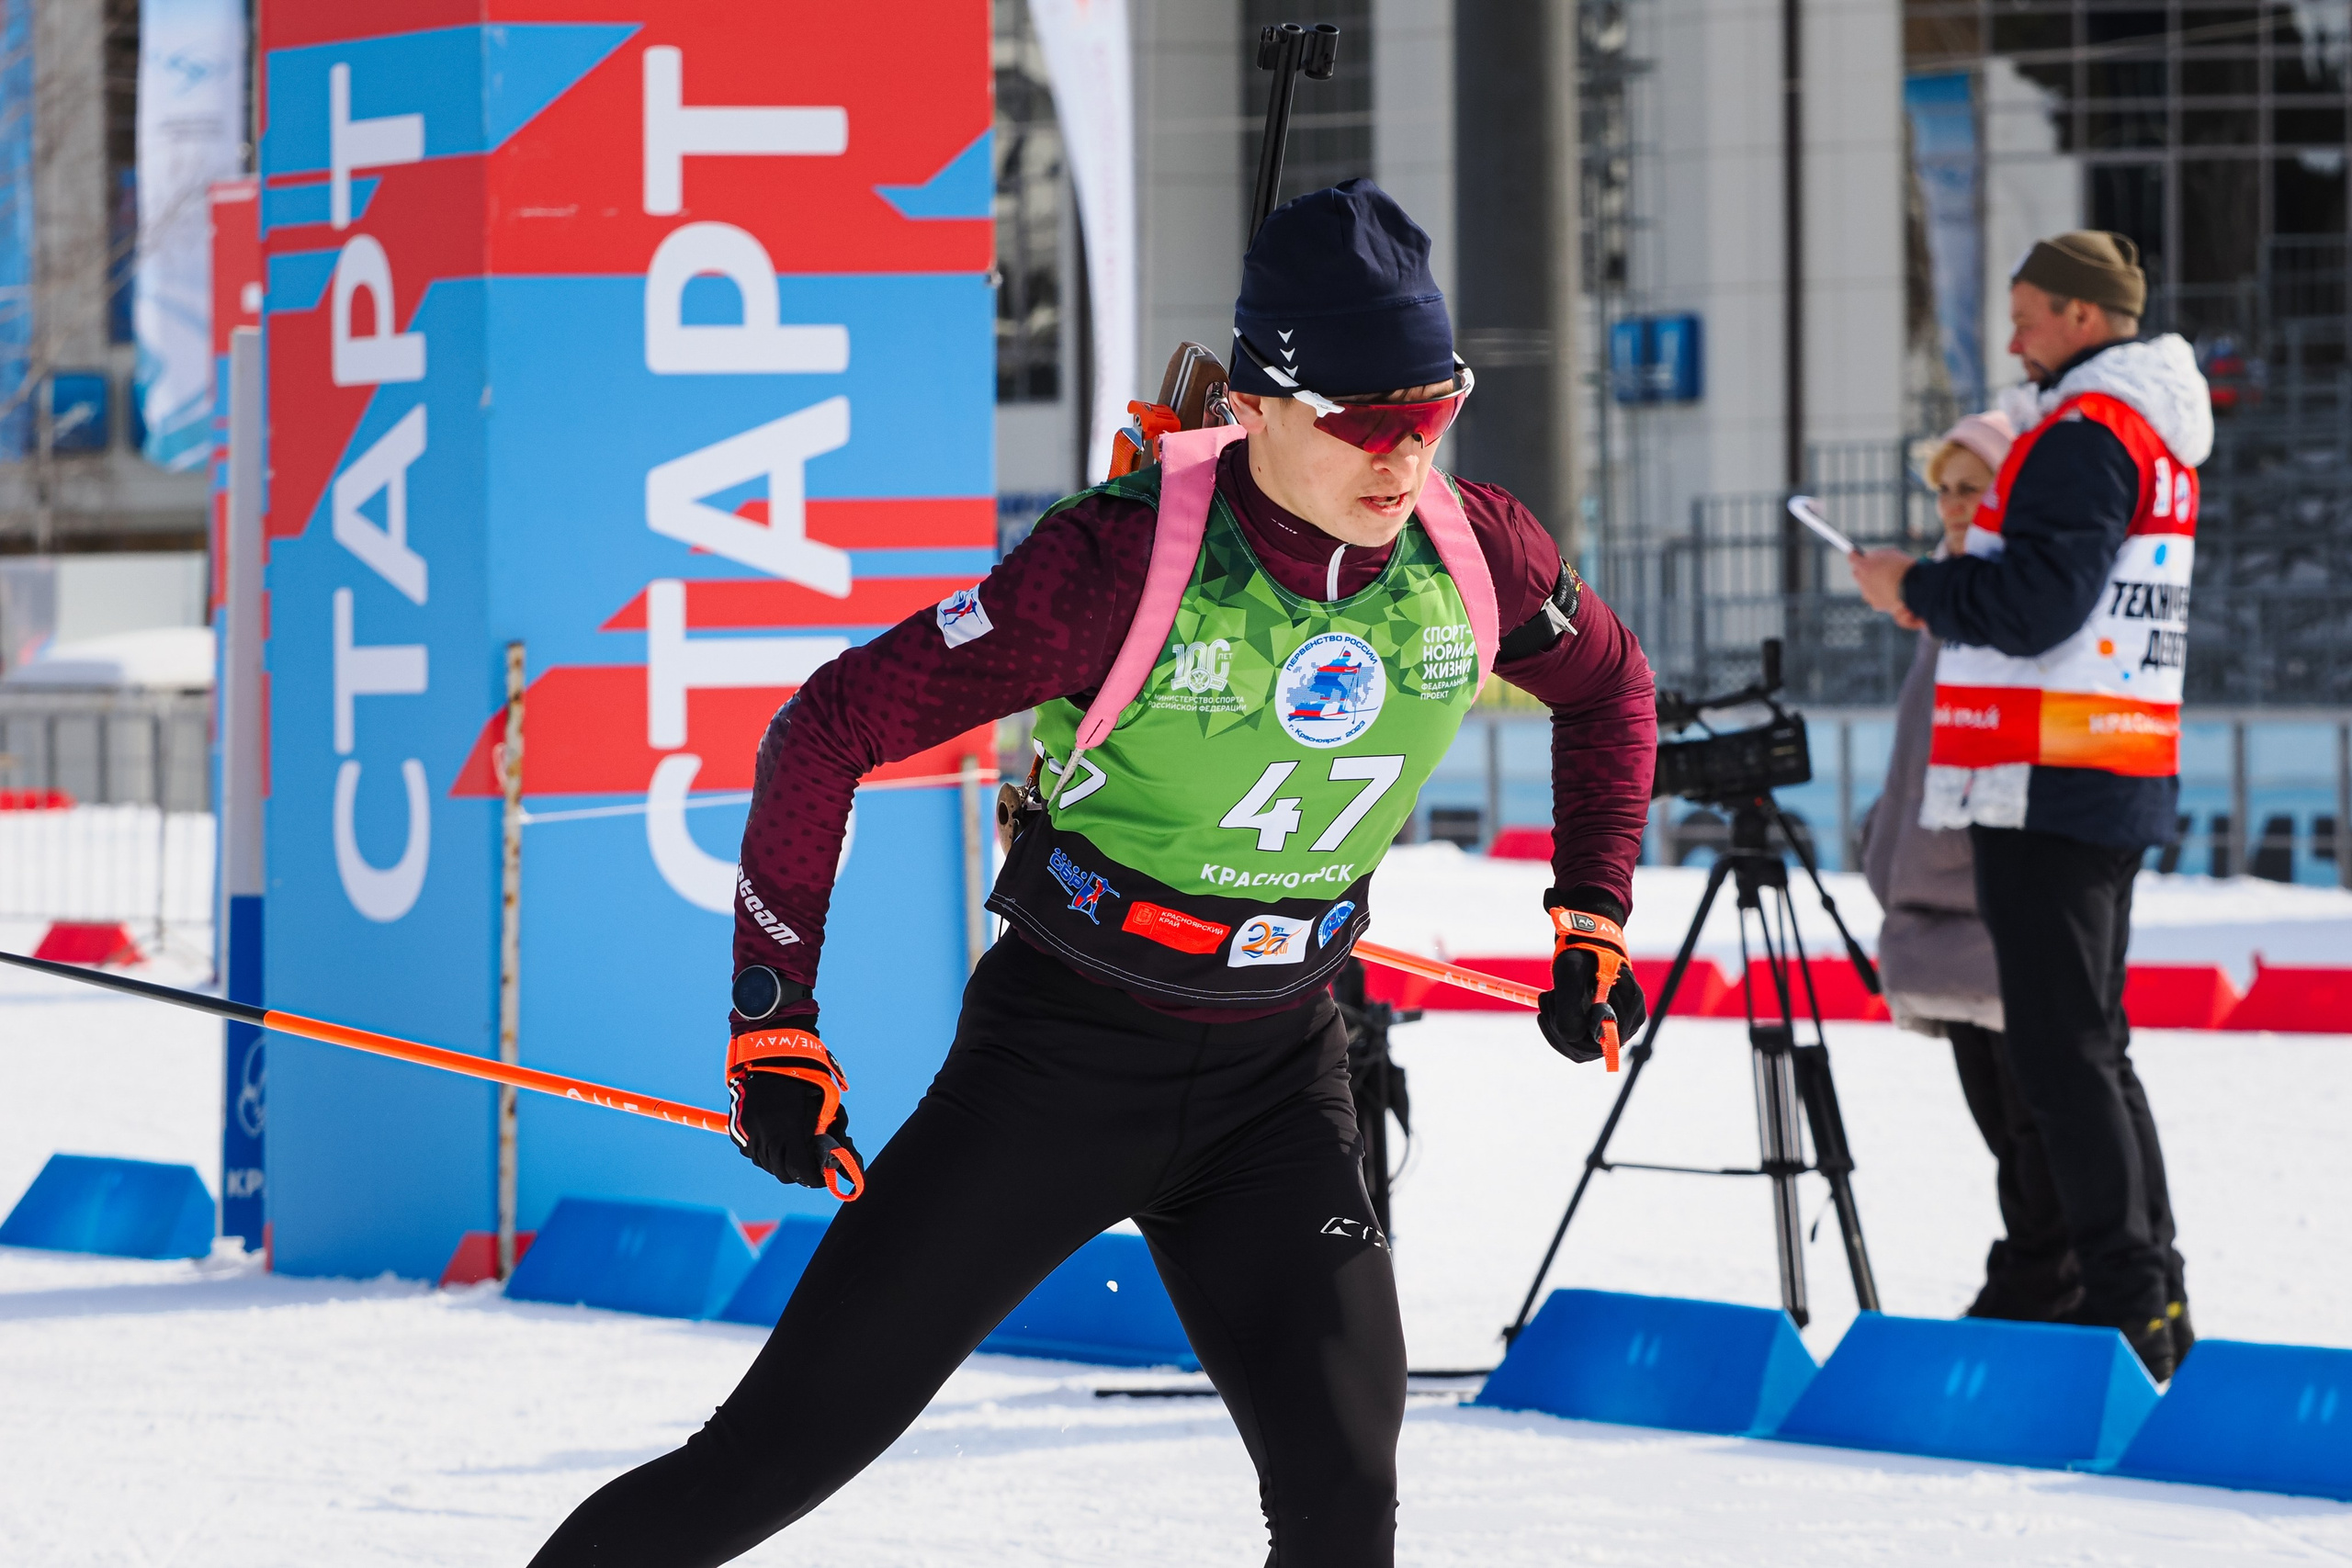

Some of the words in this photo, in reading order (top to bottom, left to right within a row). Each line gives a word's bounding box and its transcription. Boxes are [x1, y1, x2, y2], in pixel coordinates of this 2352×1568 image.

[331, 62, 430, 922] СТАРТ
[1422, 624, 1472, 643] СПОРТ-
[1217, 652, 1233, 660] ЛЕТ
[1286, 635, 1342, 671] ПЕРВЕНСТВО
[1344, 636, 1378, 665] РОССИИ
[1422, 641, 1476, 661] НОРМА
[1421, 658, 1473, 680] ЖИЗНИ
[1420, 674, 1469, 691] ФЕДЕРАЛЬНЫЙ
[1154, 694, 1214, 705] МИНИСТЕРСТВО
[1419, 690, 1449, 700] ПРОЕКТ
[1148, 700, 1197, 712] РОССИЙСКОЙ
[1198, 704, 1247, 713] ФЕДЕРАЦИИ
[1295, 728, 1341, 744] Красноярск
[1217, 754, 1407, 852] 47
[1049, 852, 1084, 889] СБР
[738, 860, 801, 946] oteam
[1159, 917, 1181, 929] КРАЙ
[1161, 911, 1224, 935] КРАСНОЯРСКИЙ
